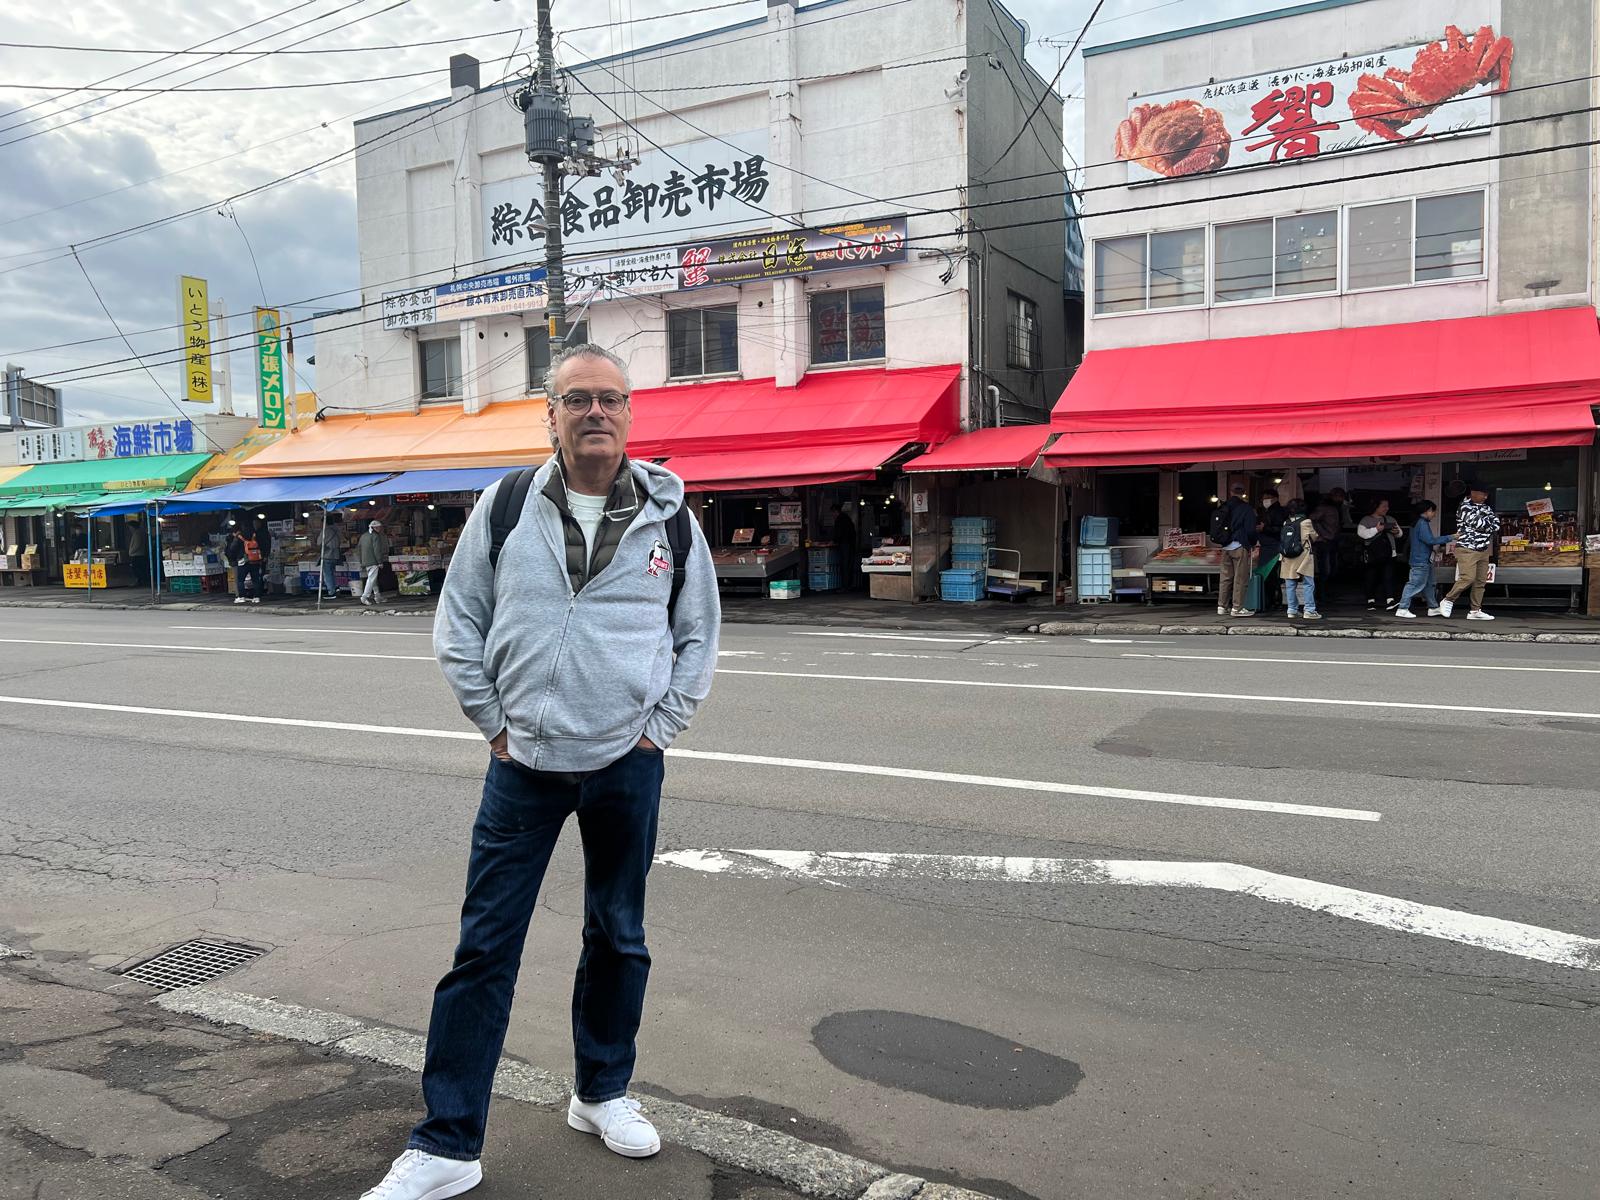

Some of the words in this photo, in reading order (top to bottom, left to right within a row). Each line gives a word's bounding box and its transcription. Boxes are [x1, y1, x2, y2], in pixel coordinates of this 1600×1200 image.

[1241, 81, 1340, 164] 響
[681, 246, 712, 287] 蟹
[262, 337, 282, 427] 夕張メロン
[113, 420, 193, 457] 海鮮市場
